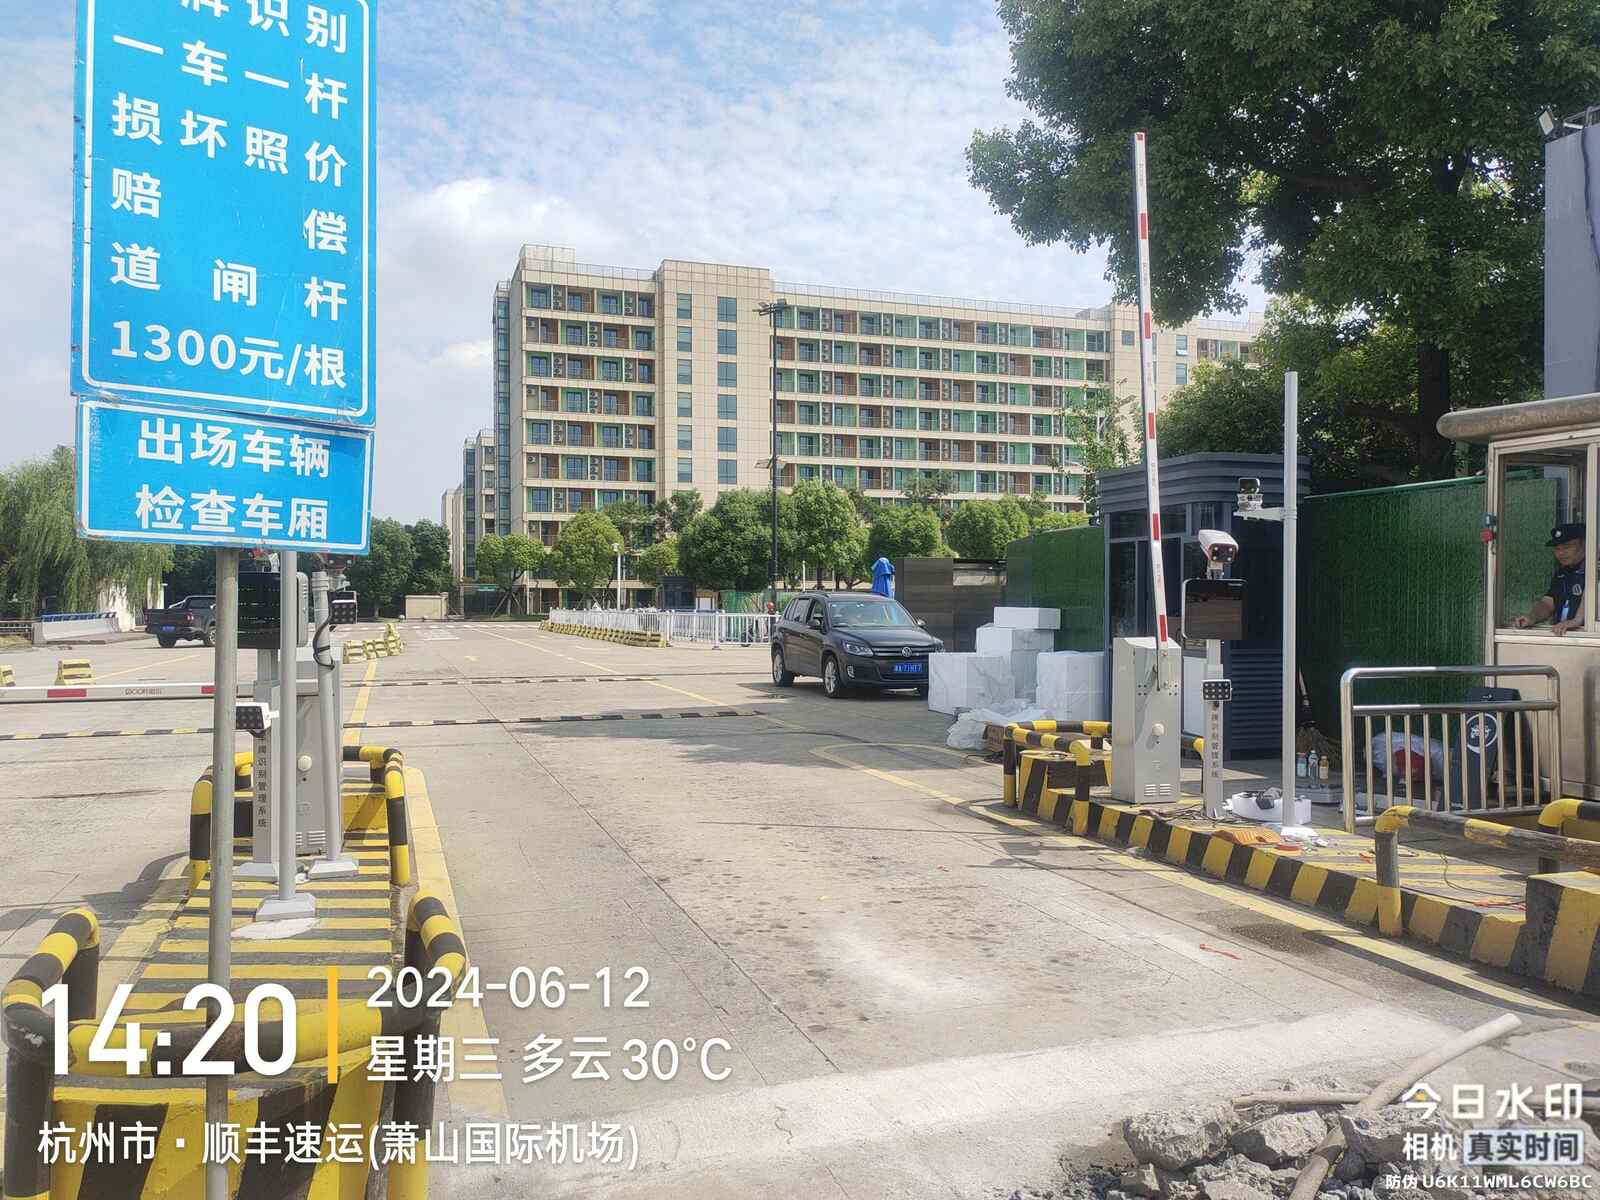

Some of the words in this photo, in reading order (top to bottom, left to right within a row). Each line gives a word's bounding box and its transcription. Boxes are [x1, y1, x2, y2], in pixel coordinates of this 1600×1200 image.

[112, 35, 348, 120] 一车一杆
[112, 92, 348, 187] 损坏照价
[111, 320, 347, 389] 1300元/根
[137, 418, 331, 478] 出场车辆
[135, 483, 329, 540] 检查车厢
